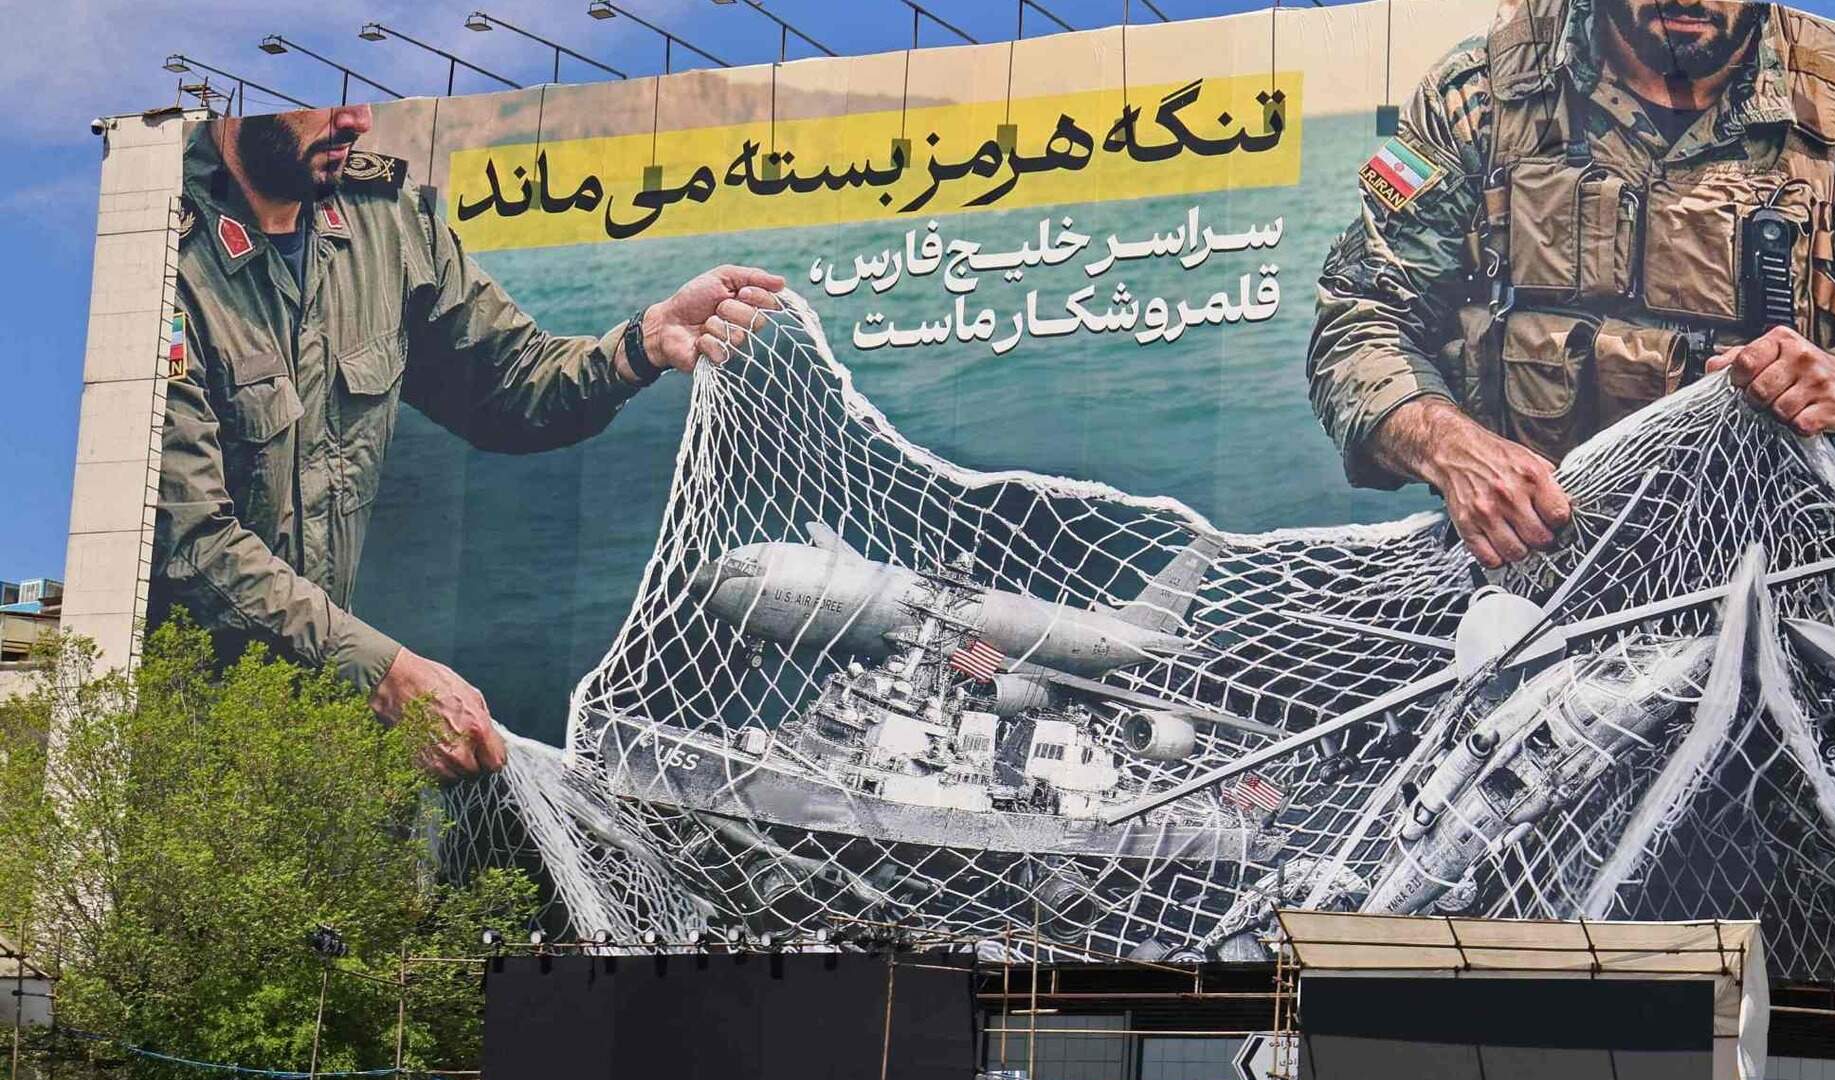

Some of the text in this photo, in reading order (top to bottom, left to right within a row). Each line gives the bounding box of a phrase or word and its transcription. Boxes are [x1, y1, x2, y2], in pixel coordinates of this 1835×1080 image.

[896, 113, 1094, 213] هرمز
[1102, 78, 1287, 163] تنگه
[724, 139, 906, 208] بسته
[808, 206, 1285, 296] سراسر خلیج فارس،
[852, 264, 1281, 354] قلمرو شکار ماست
